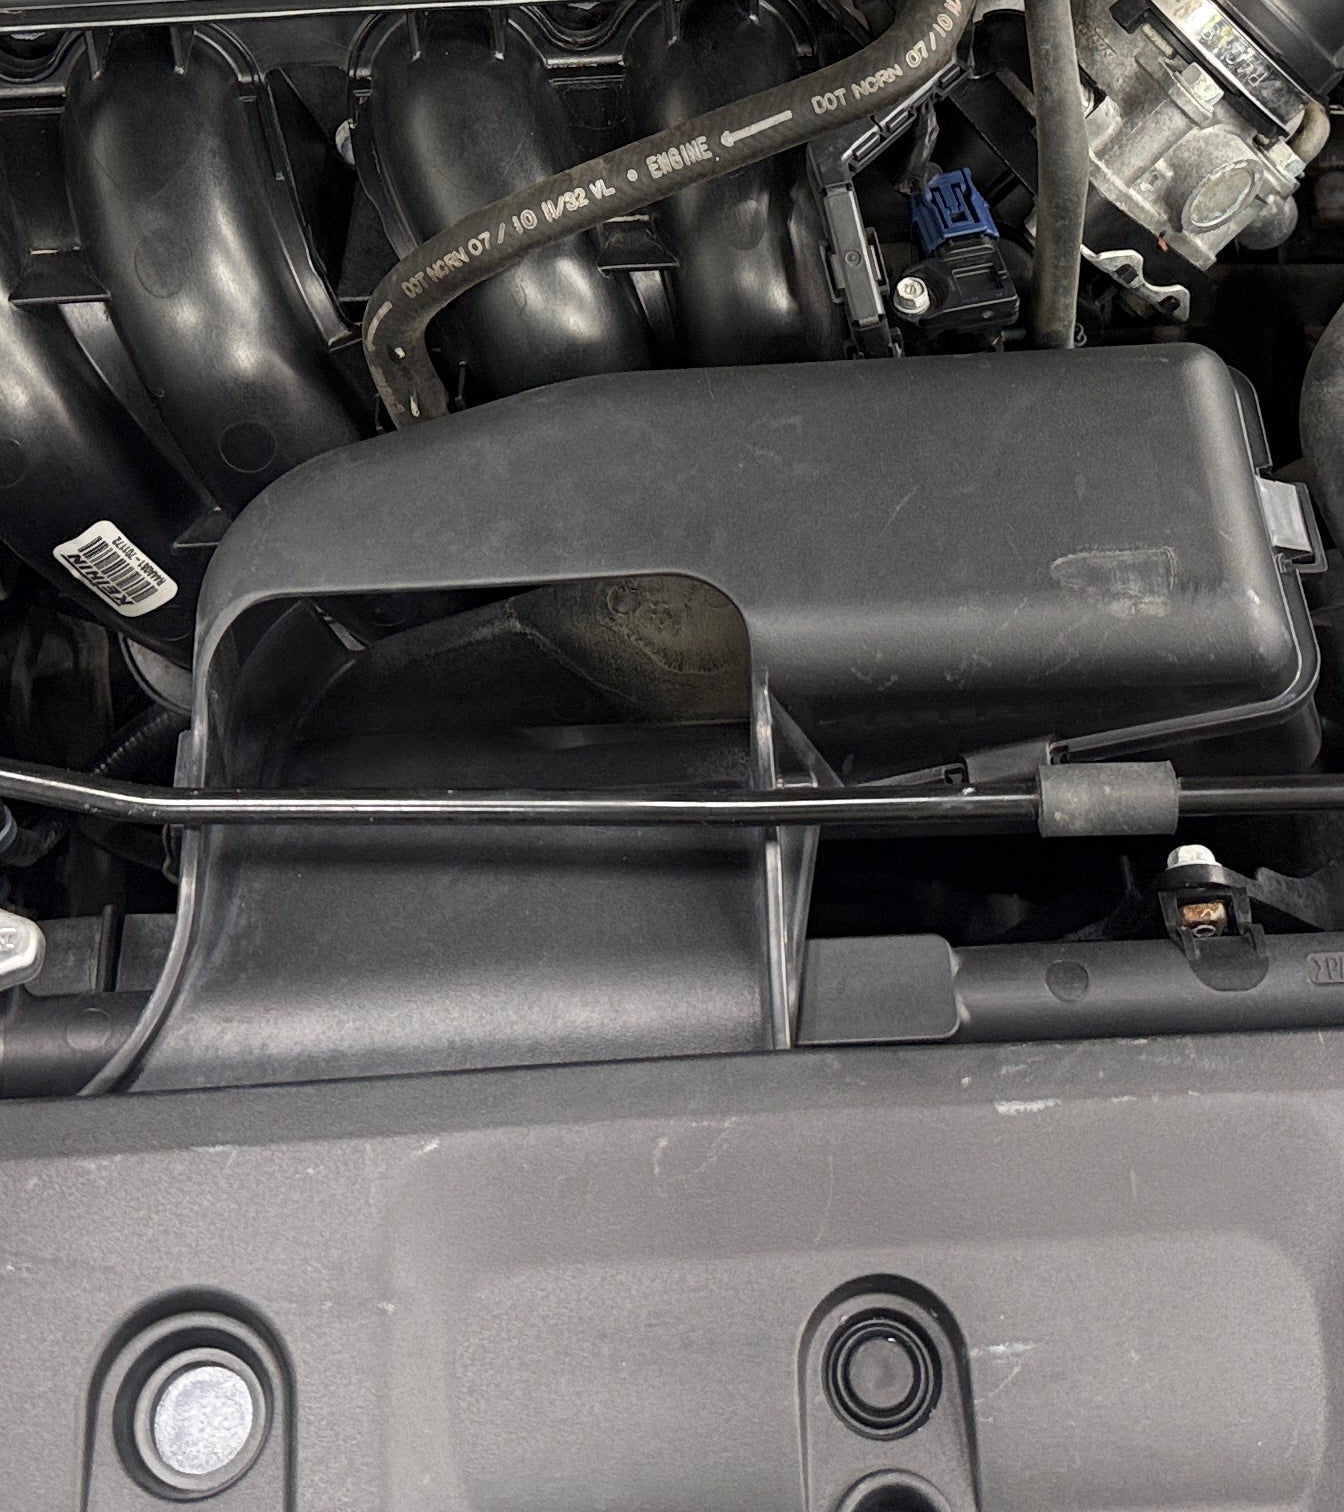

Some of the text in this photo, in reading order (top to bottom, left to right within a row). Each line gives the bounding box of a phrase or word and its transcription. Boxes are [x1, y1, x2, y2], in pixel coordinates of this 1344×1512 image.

[811, 87, 848, 116] DOT
[905, 39, 930, 69] 07
[932, 13, 955, 39] 10
[401, 272, 430, 299] DOT
[467, 231, 492, 257] 07
[511, 208, 538, 235] 10
[645, 135, 714, 179] ENGINE
[67, 553, 135, 605] KEIHIN
